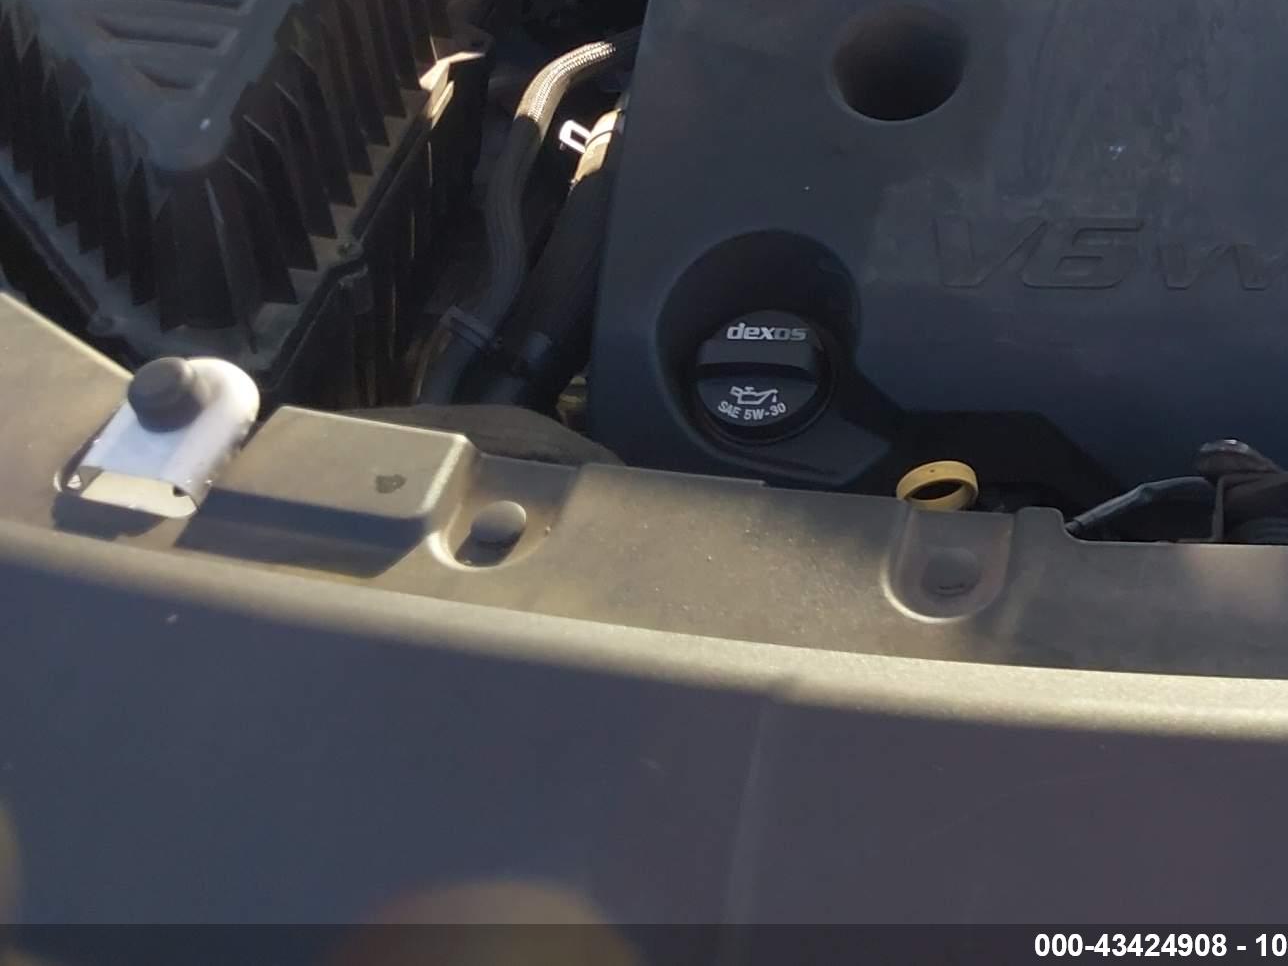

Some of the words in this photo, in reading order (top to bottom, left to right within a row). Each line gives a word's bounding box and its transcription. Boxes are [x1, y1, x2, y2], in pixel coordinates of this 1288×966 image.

[933, 217, 1146, 289] V6
[726, 322, 809, 341] dexos
[717, 400, 742, 419] SAE
[743, 402, 787, 420] 5W-30
